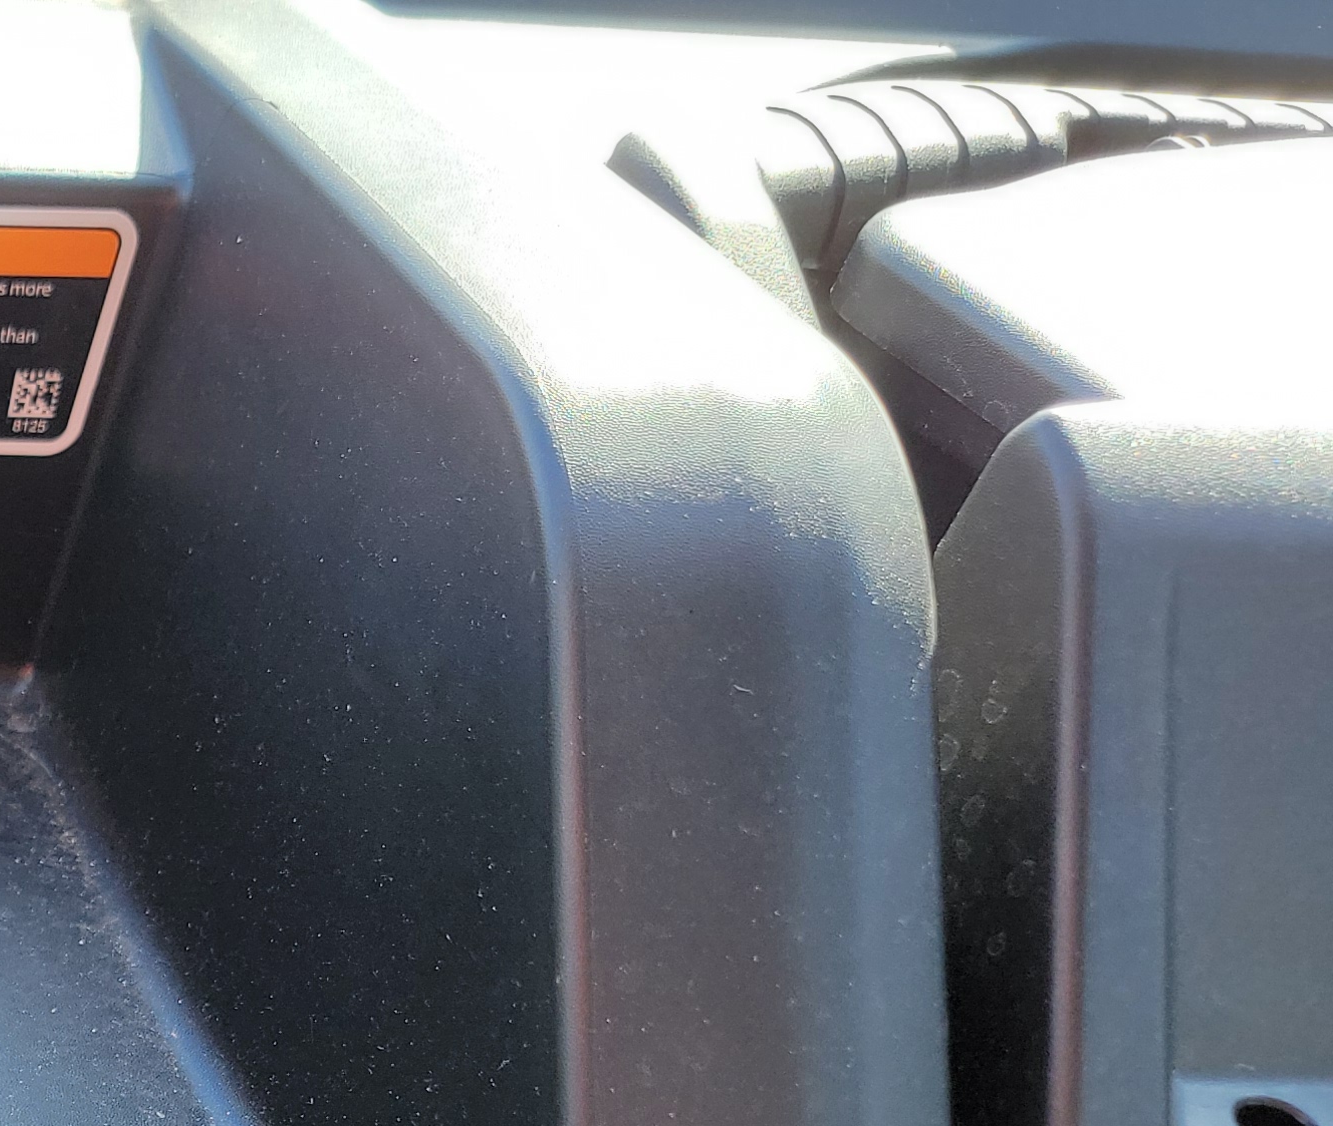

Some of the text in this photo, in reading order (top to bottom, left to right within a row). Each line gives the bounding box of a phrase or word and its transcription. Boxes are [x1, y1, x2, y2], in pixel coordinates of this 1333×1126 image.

[9, 282, 54, 298] more
[0, 324, 39, 344] than
[11, 419, 49, 434] 8125
